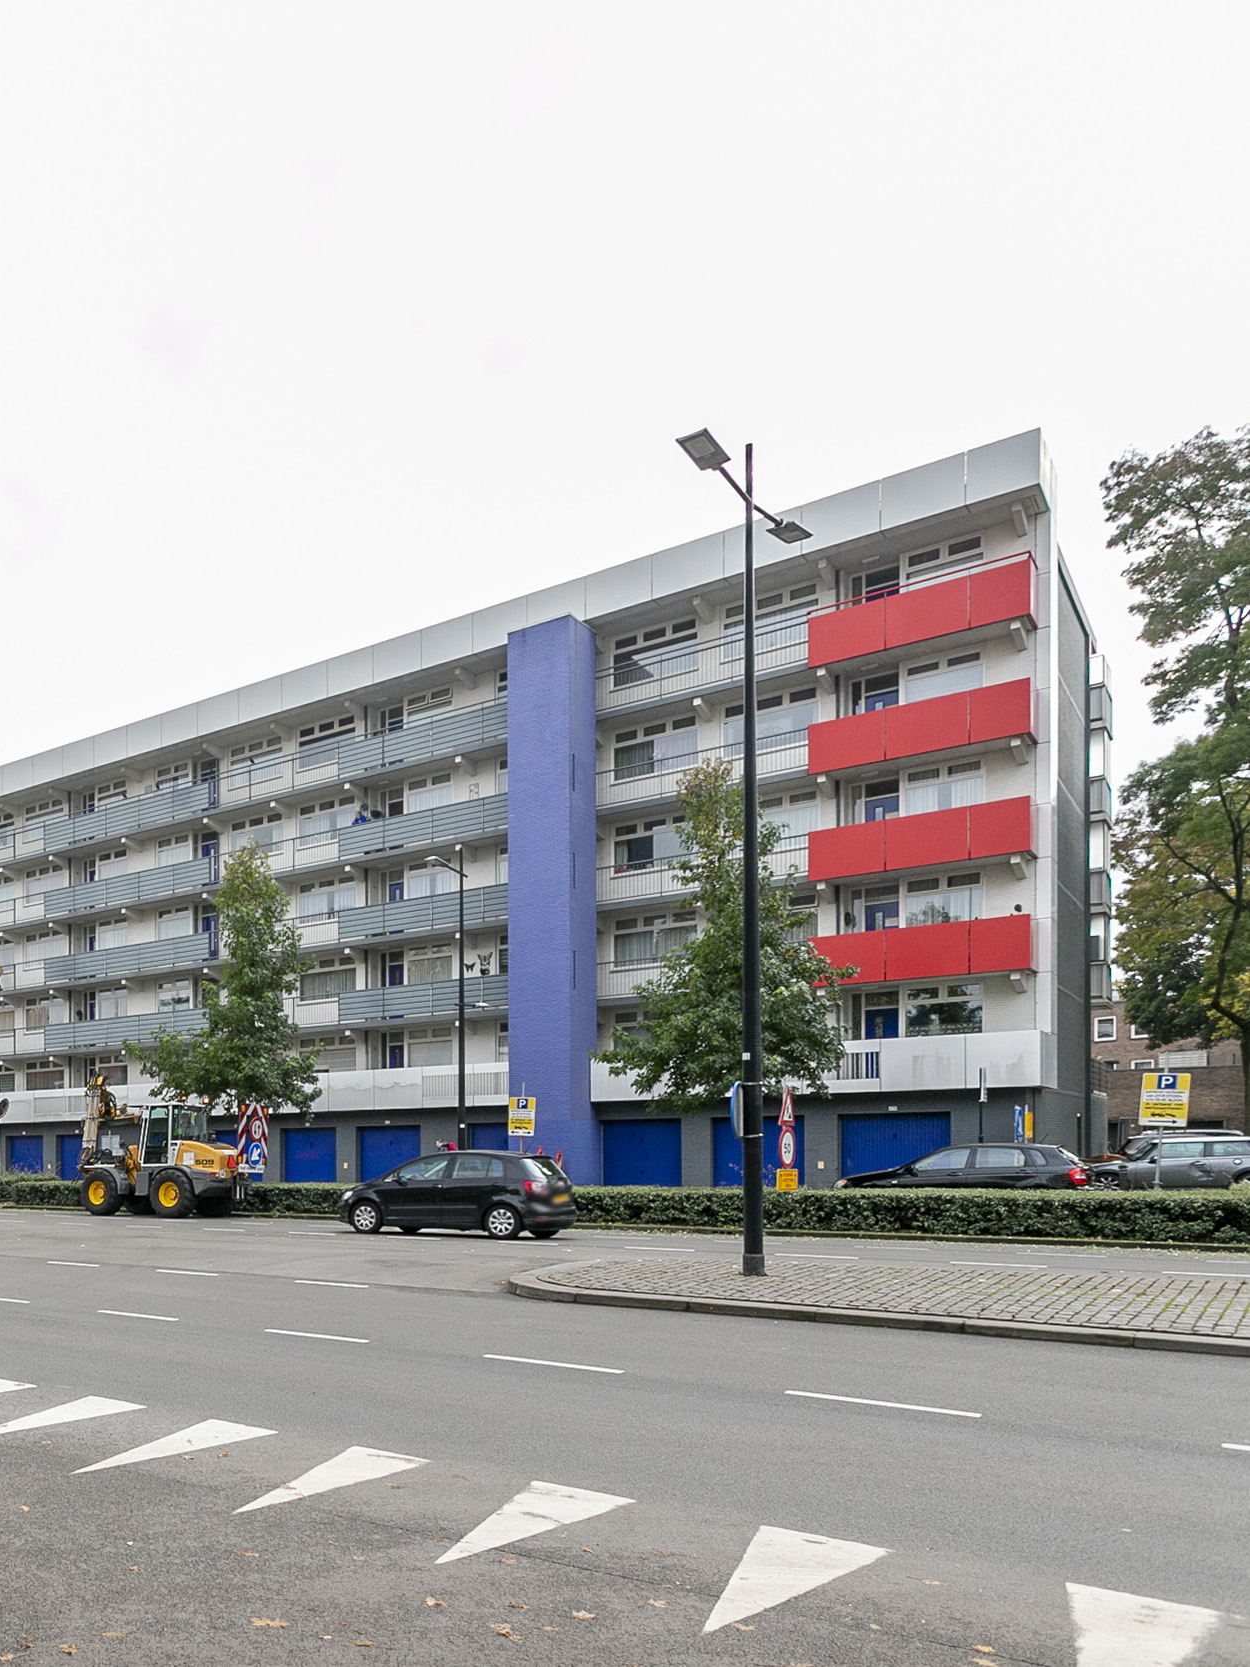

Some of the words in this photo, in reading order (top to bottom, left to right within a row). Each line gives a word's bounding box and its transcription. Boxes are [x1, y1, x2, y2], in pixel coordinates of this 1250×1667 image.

[1160, 1076, 1174, 1089] P
[519, 1099, 527, 1109] P
[783, 1143, 792, 1154] 50
